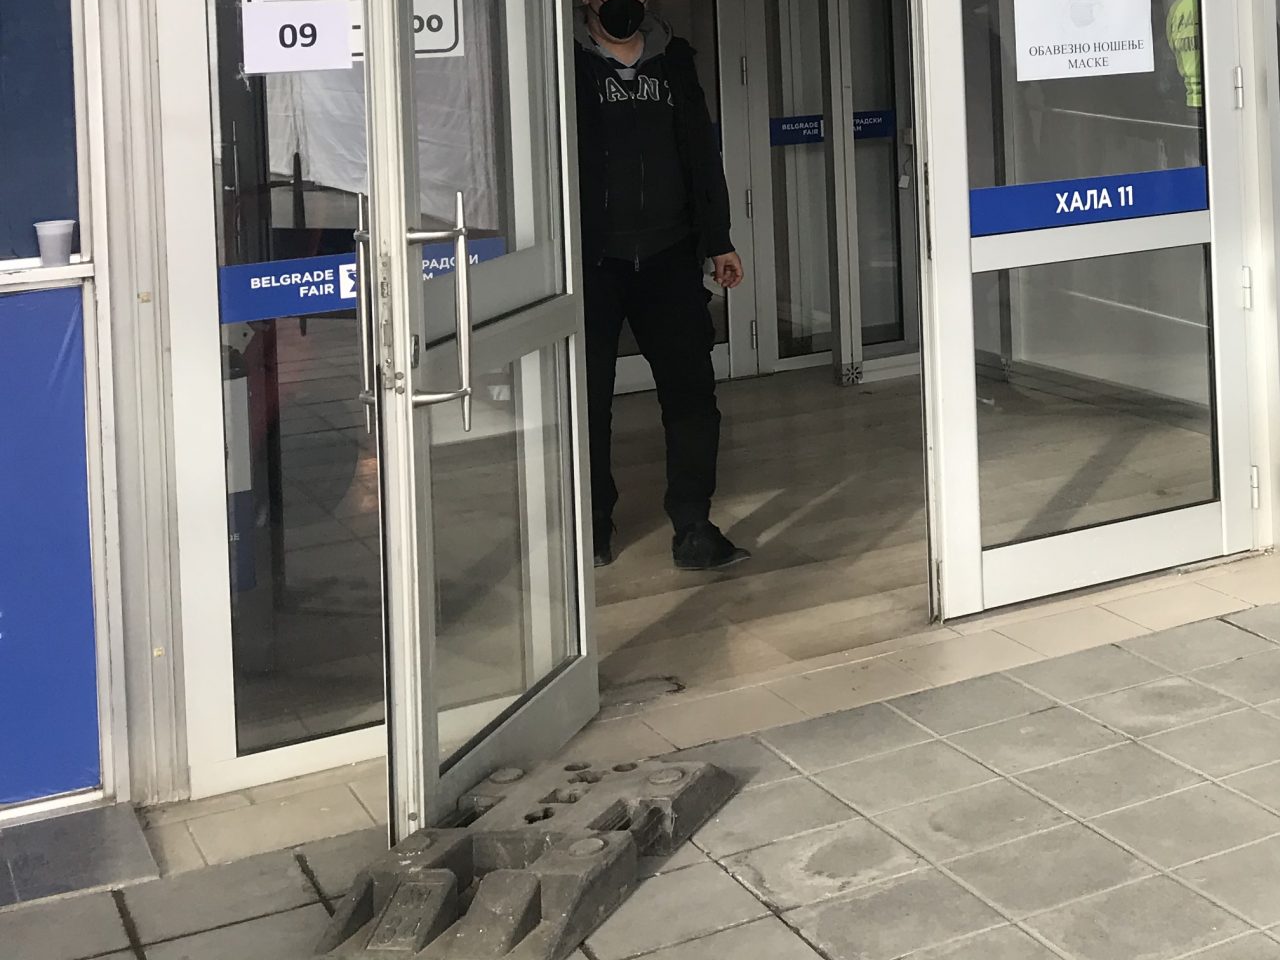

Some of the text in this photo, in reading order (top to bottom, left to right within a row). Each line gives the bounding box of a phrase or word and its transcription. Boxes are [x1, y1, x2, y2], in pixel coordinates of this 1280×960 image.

[277, 21, 319, 50] 09
[1029, 40, 1145, 57] ОБАВЕЗНО НОШЕЊЕ
[1068, 56, 1109, 70] МАСКЕ
[782, 121, 819, 131] BELGRADE
[803, 128, 819, 136] FAIR
[1055, 185, 1133, 214] ХАЛА 11
[250, 269, 334, 290] BELGRADE
[299, 283, 334, 298] FAIR
